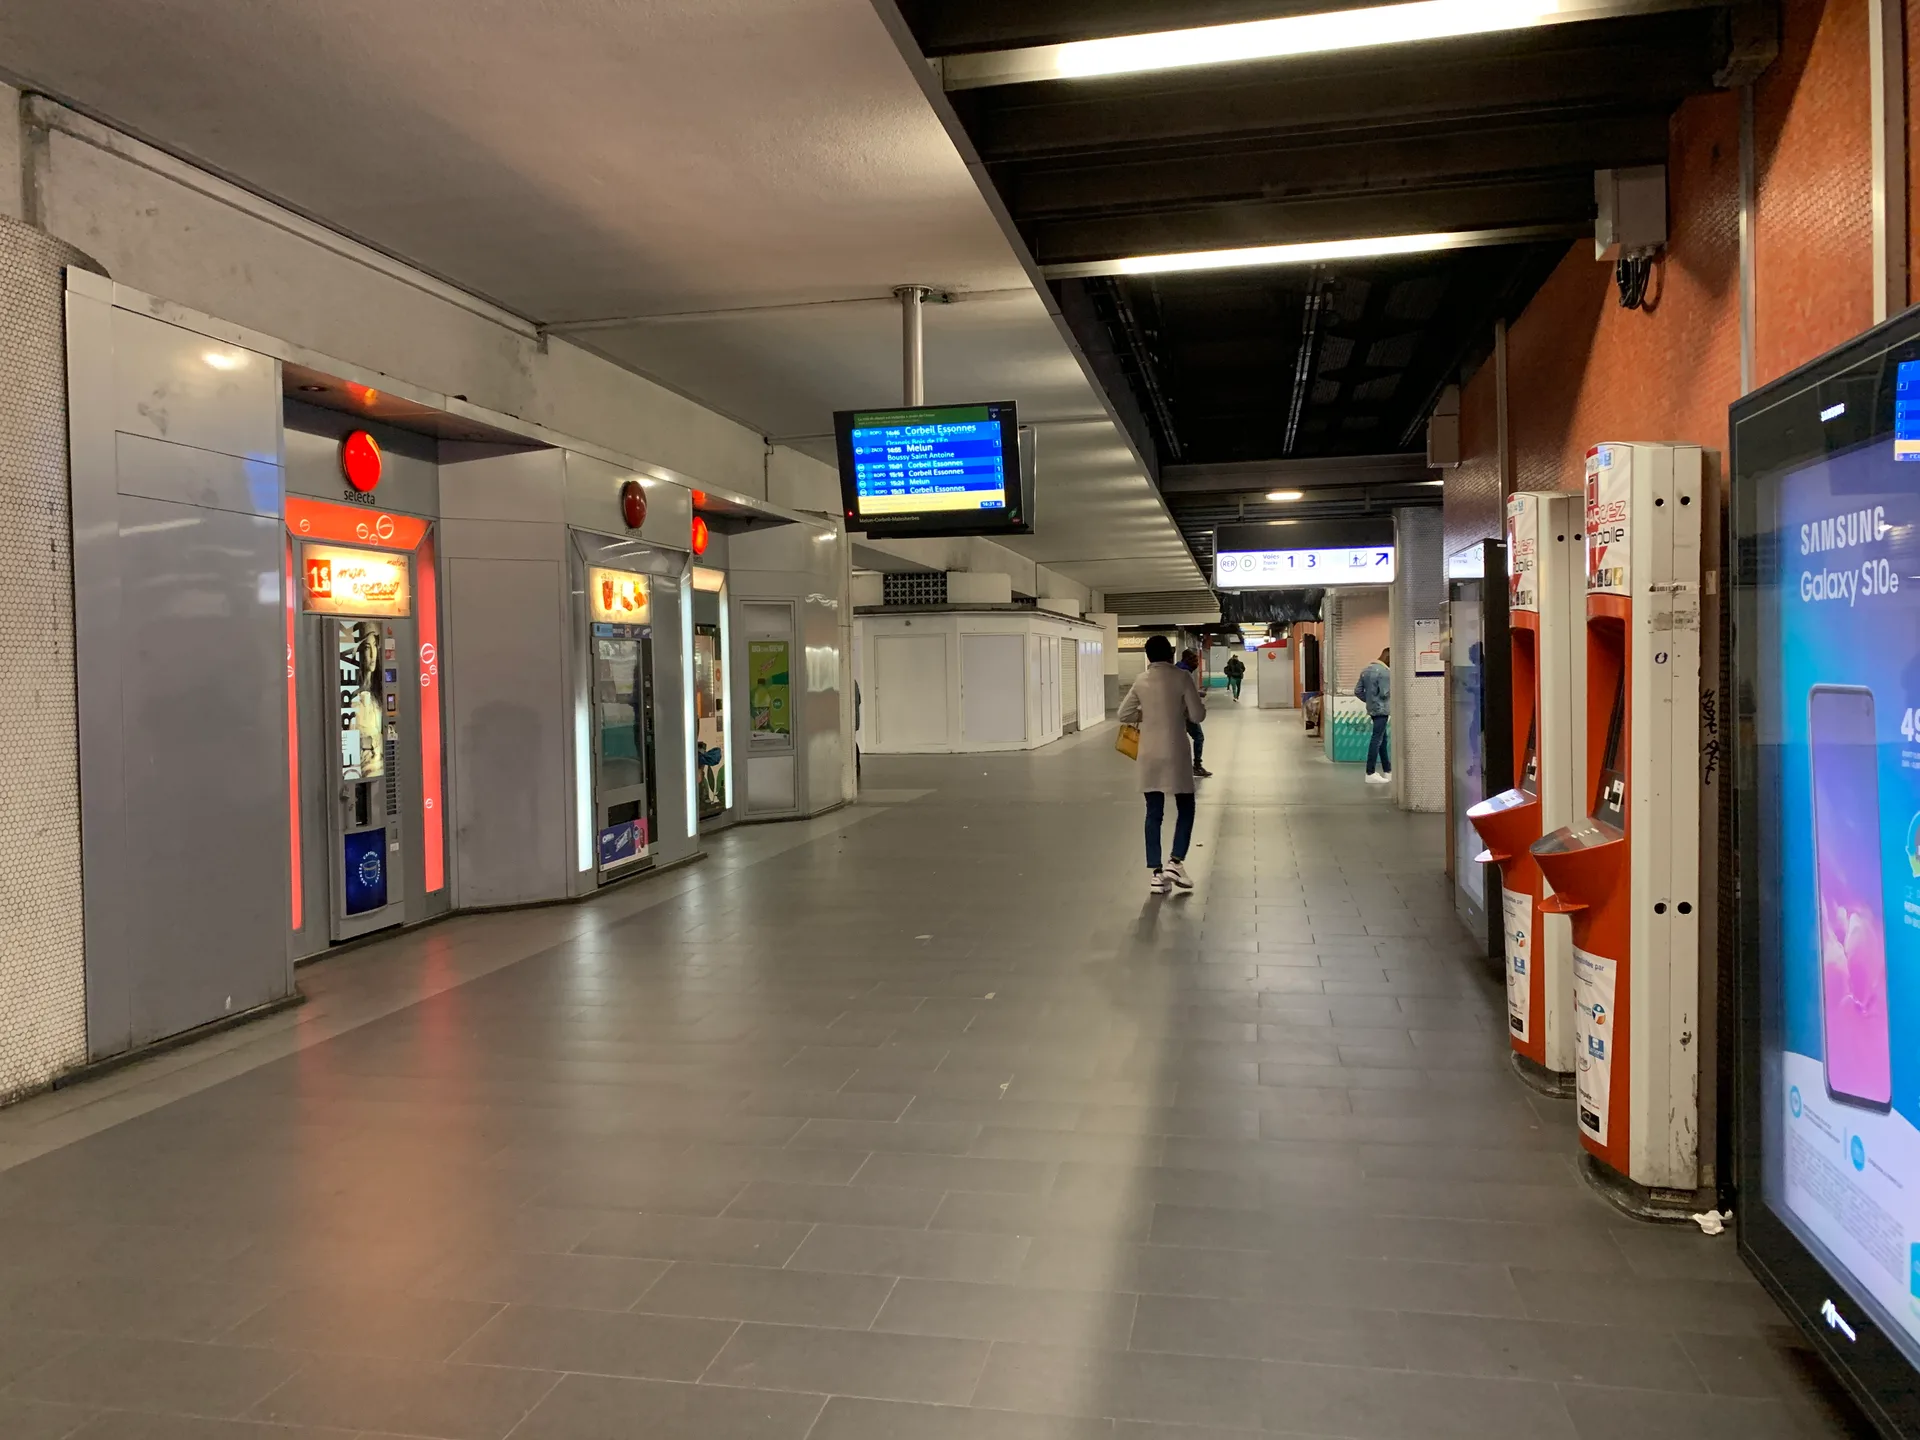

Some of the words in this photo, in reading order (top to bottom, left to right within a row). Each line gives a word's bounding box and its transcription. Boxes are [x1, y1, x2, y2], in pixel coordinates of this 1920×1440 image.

[905, 425, 935, 435] Corbeil
[937, 425, 976, 434] Essonnes
[906, 444, 933, 452] Melun
[908, 460, 932, 468] Corbeil
[344, 490, 375, 504] selecta
[1801, 506, 1884, 555] SAMSUNG
[1287, 556, 1294, 568] 1
[1307, 554, 1316, 568] 3
[1800, 568, 1859, 607] Galaxy
[1861, 558, 1899, 596] S10e
